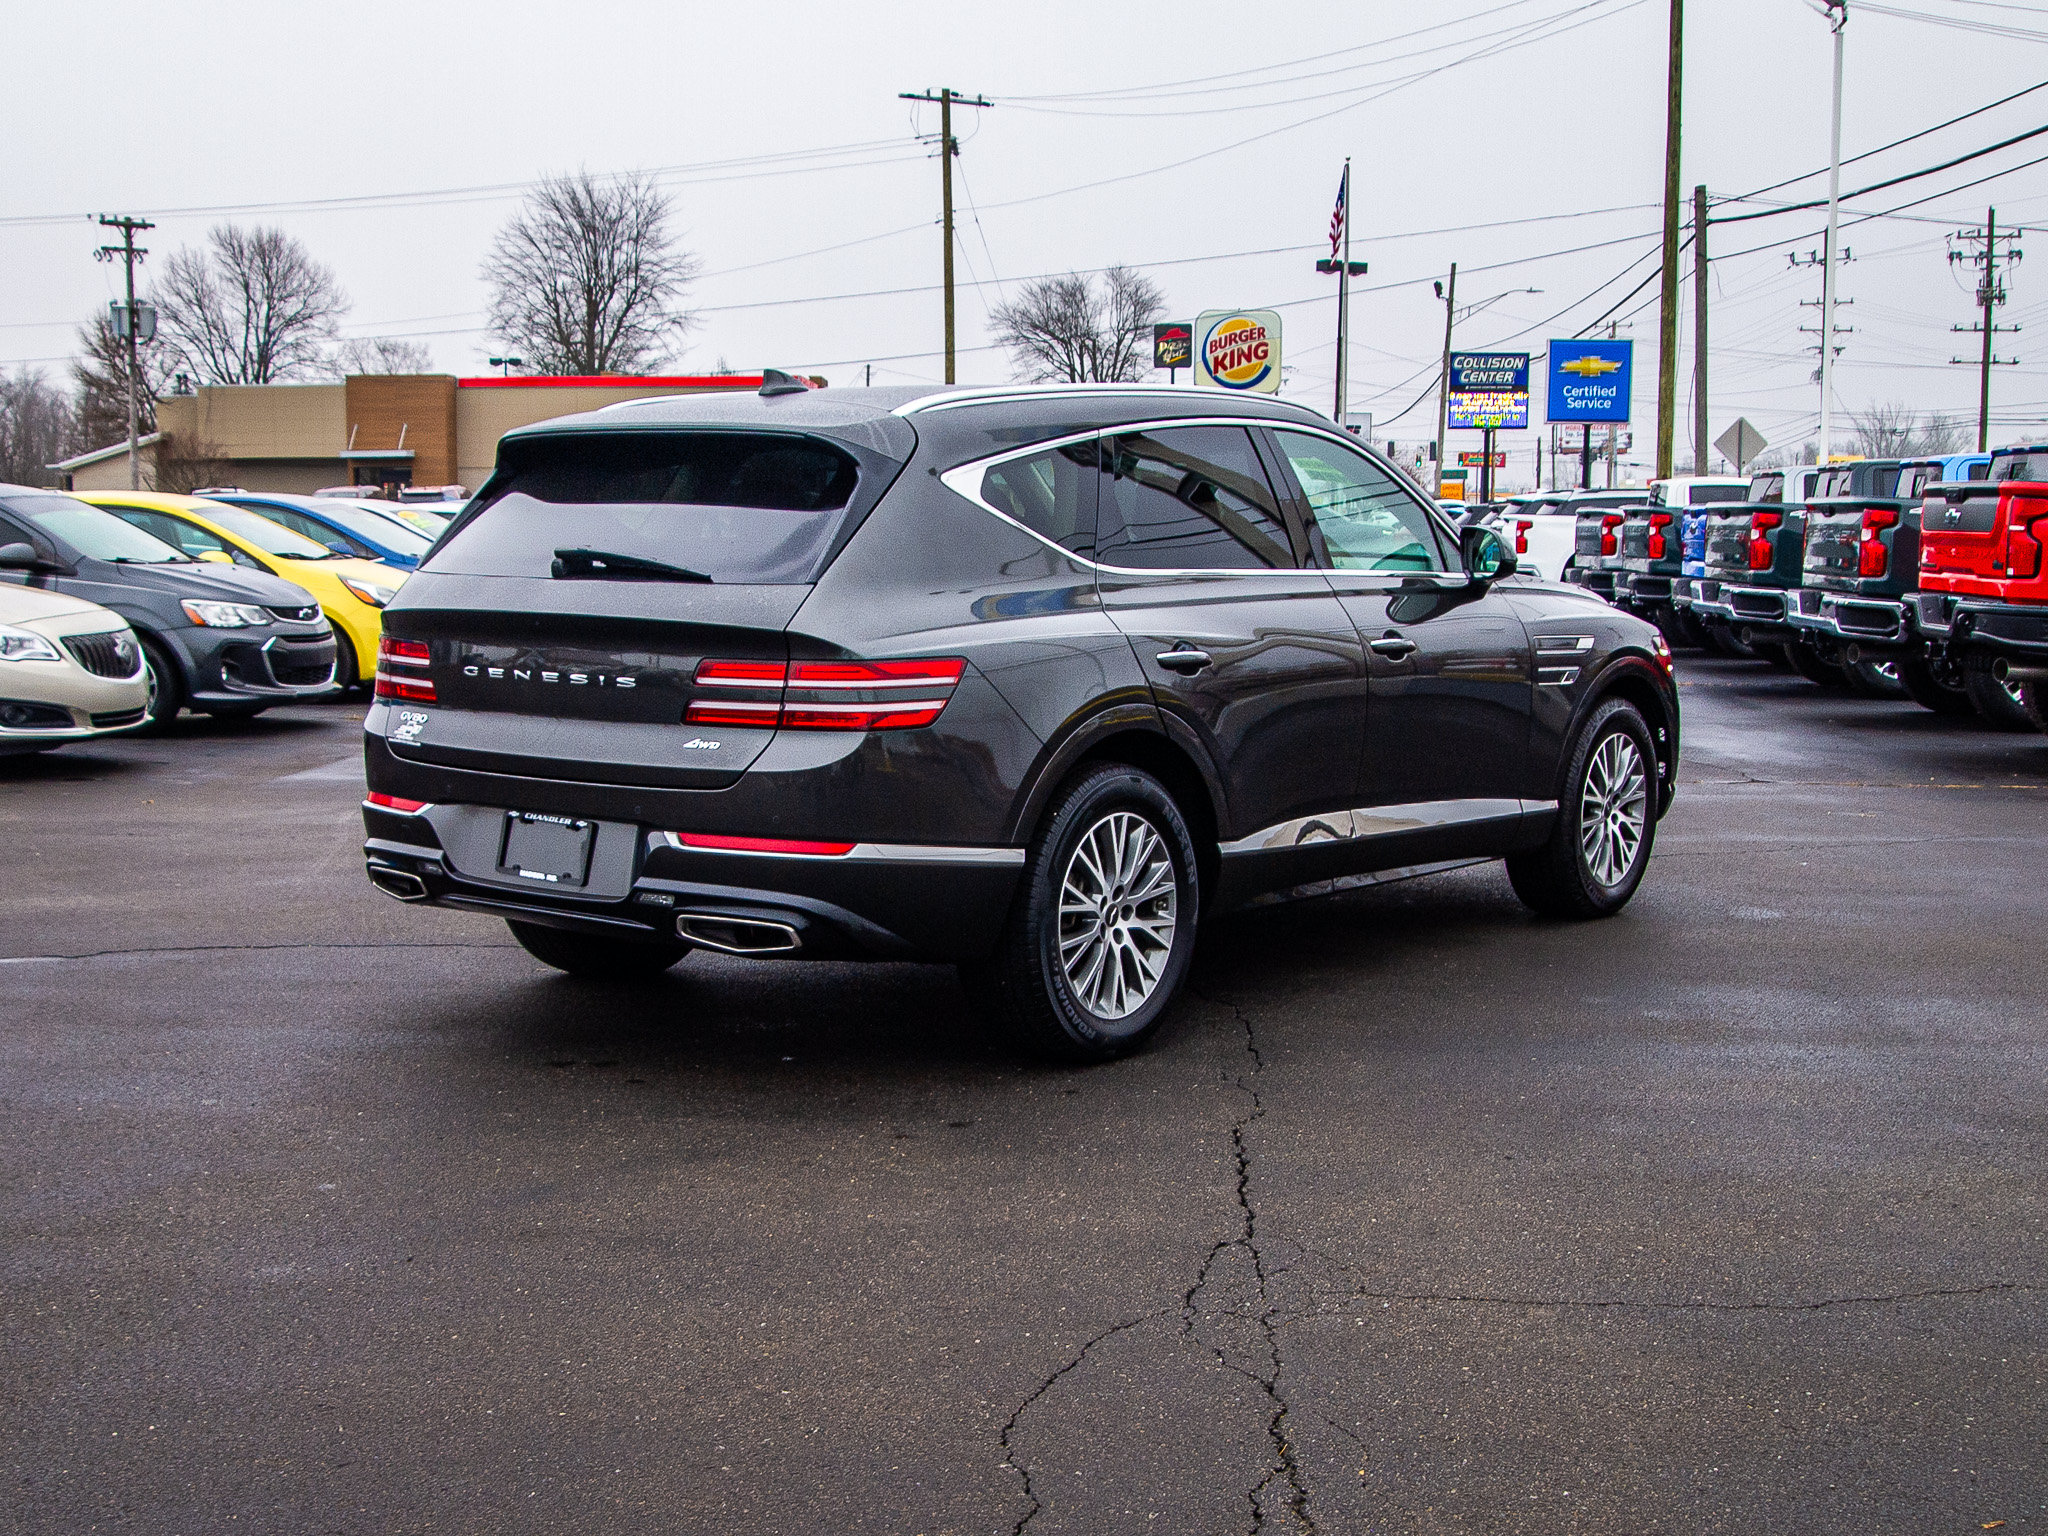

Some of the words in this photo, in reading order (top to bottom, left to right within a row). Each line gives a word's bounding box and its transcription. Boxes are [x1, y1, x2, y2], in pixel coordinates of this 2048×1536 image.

[1209, 326, 1266, 354] BURGER
[1212, 341, 1269, 376] KING
[1454, 356, 1525, 369] COLLISION
[1460, 370, 1515, 383] CENTER
[1563, 385, 1616, 397] Certified
[1567, 398, 1612, 409] Service
[464, 665, 637, 688] GENESIS
[524, 812, 572, 825] CHANDLER
